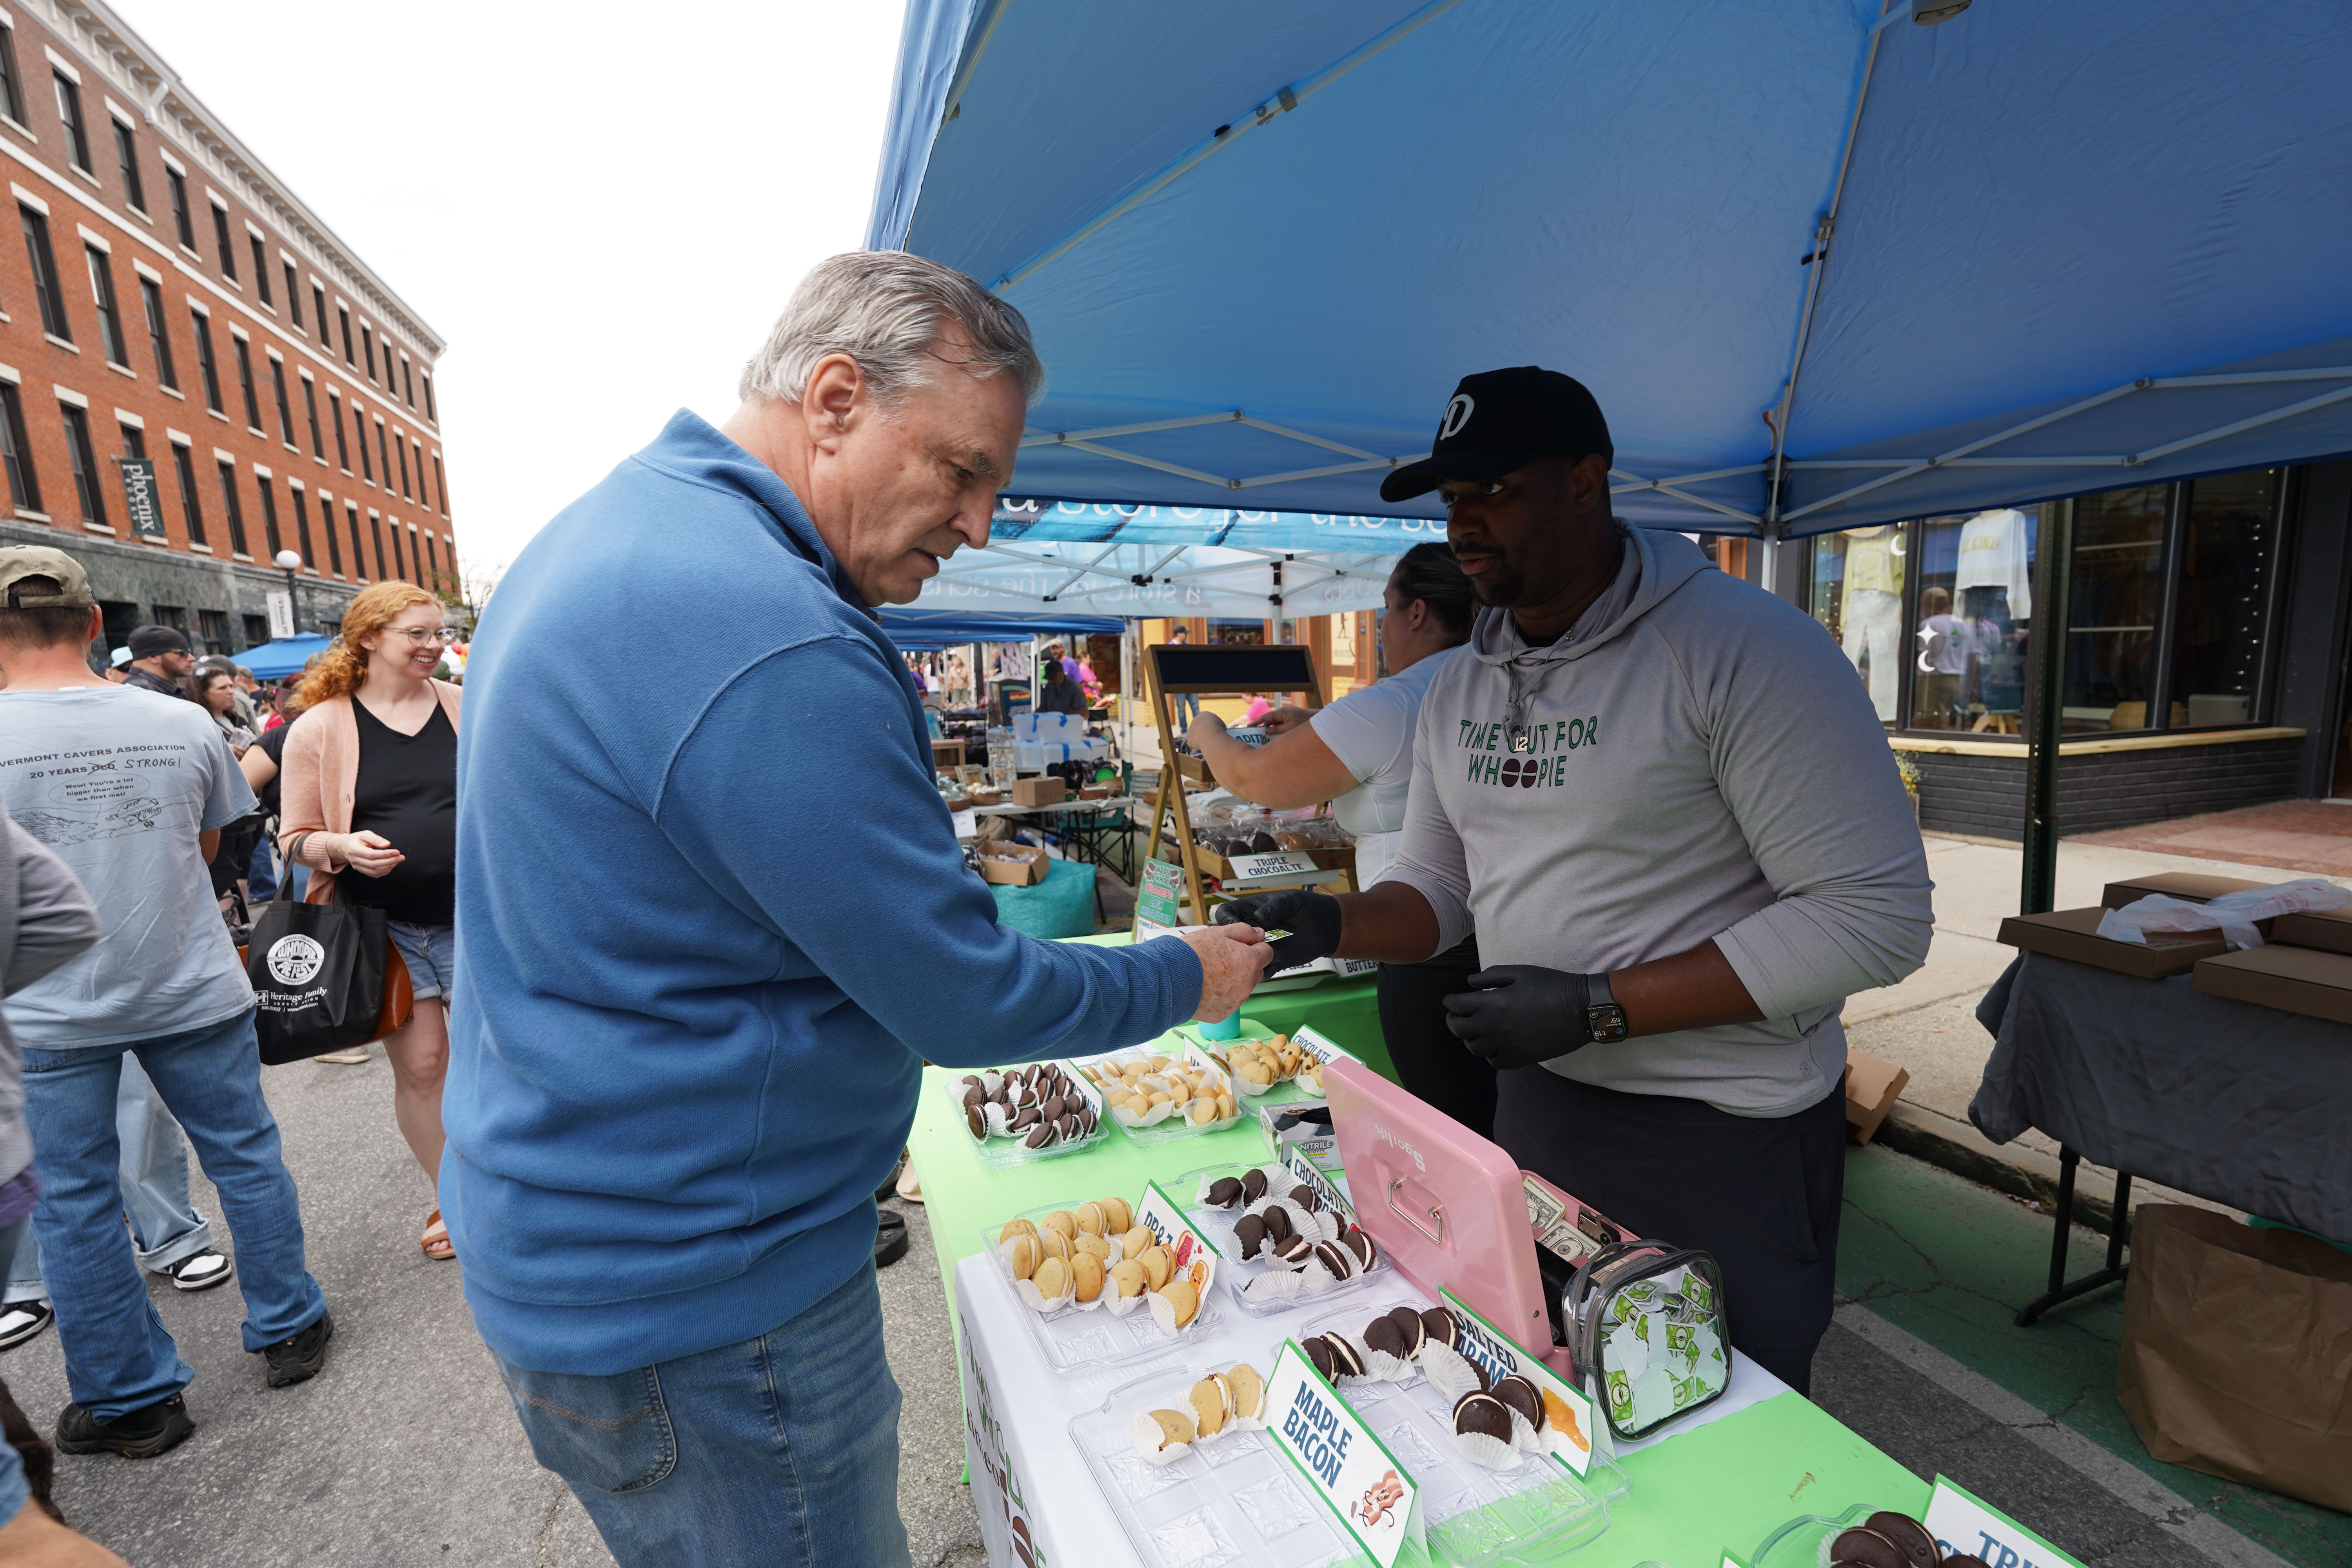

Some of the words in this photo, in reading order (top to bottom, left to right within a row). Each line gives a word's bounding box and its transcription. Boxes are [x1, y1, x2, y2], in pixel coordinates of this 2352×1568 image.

[1439, 393, 1475, 441] D
[122, 464, 154, 530] phoenix
[1458, 720, 1502, 750] TIME
[1554, 715, 1597, 751] FOR
[0, 753, 60, 767] VERMONT
[64, 748, 112, 759] CAVERS
[116, 744, 186, 754] ASSOCIATION
[1514, 737, 1528, 752] 12
[30, 771, 44, 779] 20
[48, 766, 87, 776] YEARS
[124, 758, 181, 769] STRONG!
[1248, 863, 1305, 876] CHOCOALTE
[1254, 857, 1289, 866] TRIPLE
[1150, 898, 1163, 910] CASH
[277, 941, 317, 959] WHOOPIE
[1345, 960, 1378, 973] BUTTER
[270, 991, 303, 1003] Heritage
[305, 987, 328, 1000] Family
[1293, 1035, 1332, 1064] CHOCOLATE
[1299, 1141, 1332, 1151] NITRILE
[1294, 1158, 1346, 1216] CHOCOLATE
[1455, 1310, 1517, 1373] SALTED
[1294, 1380, 1352, 1461] MAPLE
[1283, 1406, 1342, 1489] BACON
